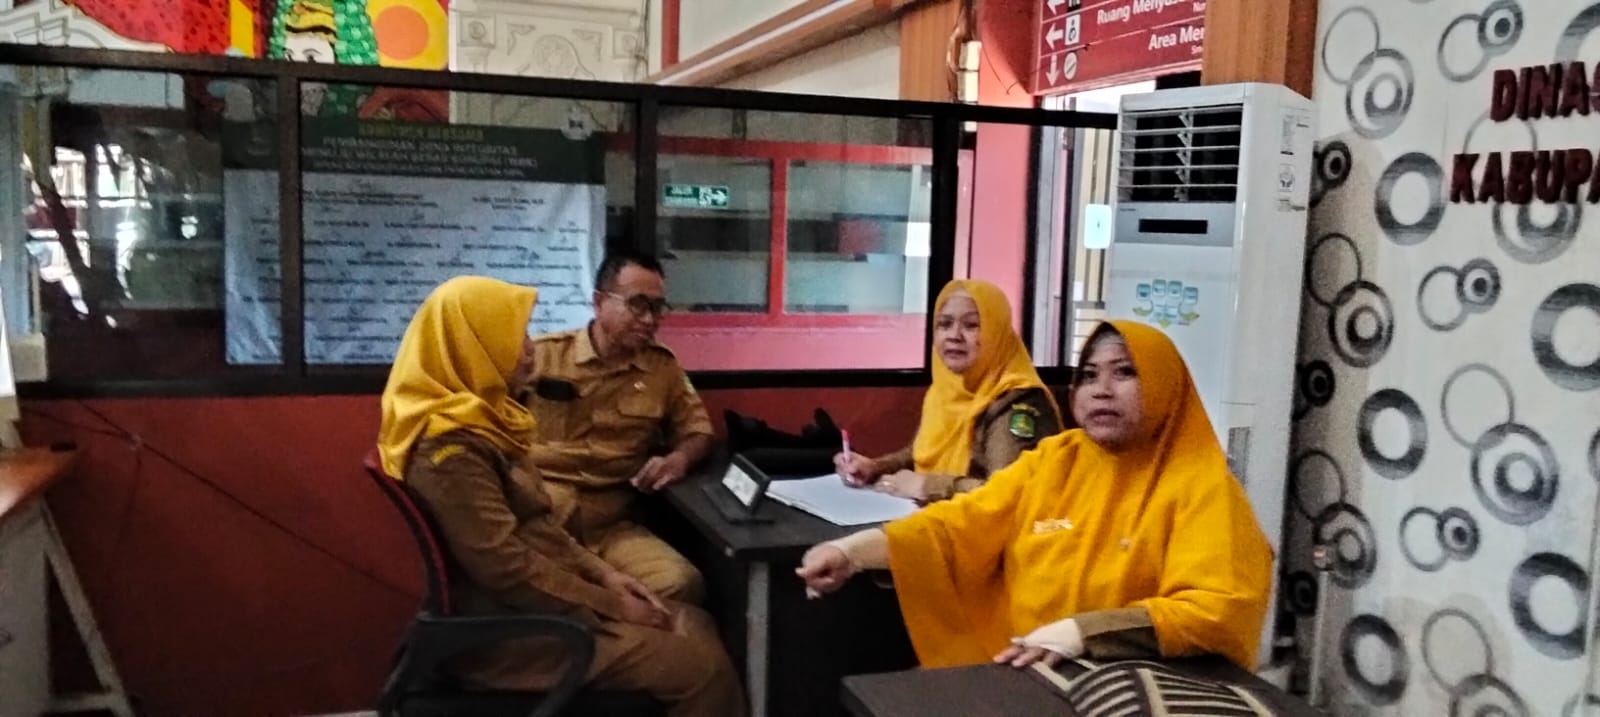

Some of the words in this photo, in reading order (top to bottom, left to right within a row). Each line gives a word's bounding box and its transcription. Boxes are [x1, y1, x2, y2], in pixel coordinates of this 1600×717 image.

[1097, 5, 1131, 25] Ruang
[1132, 0, 1186, 15] Menyu
[1148, 34, 1177, 50] Area
